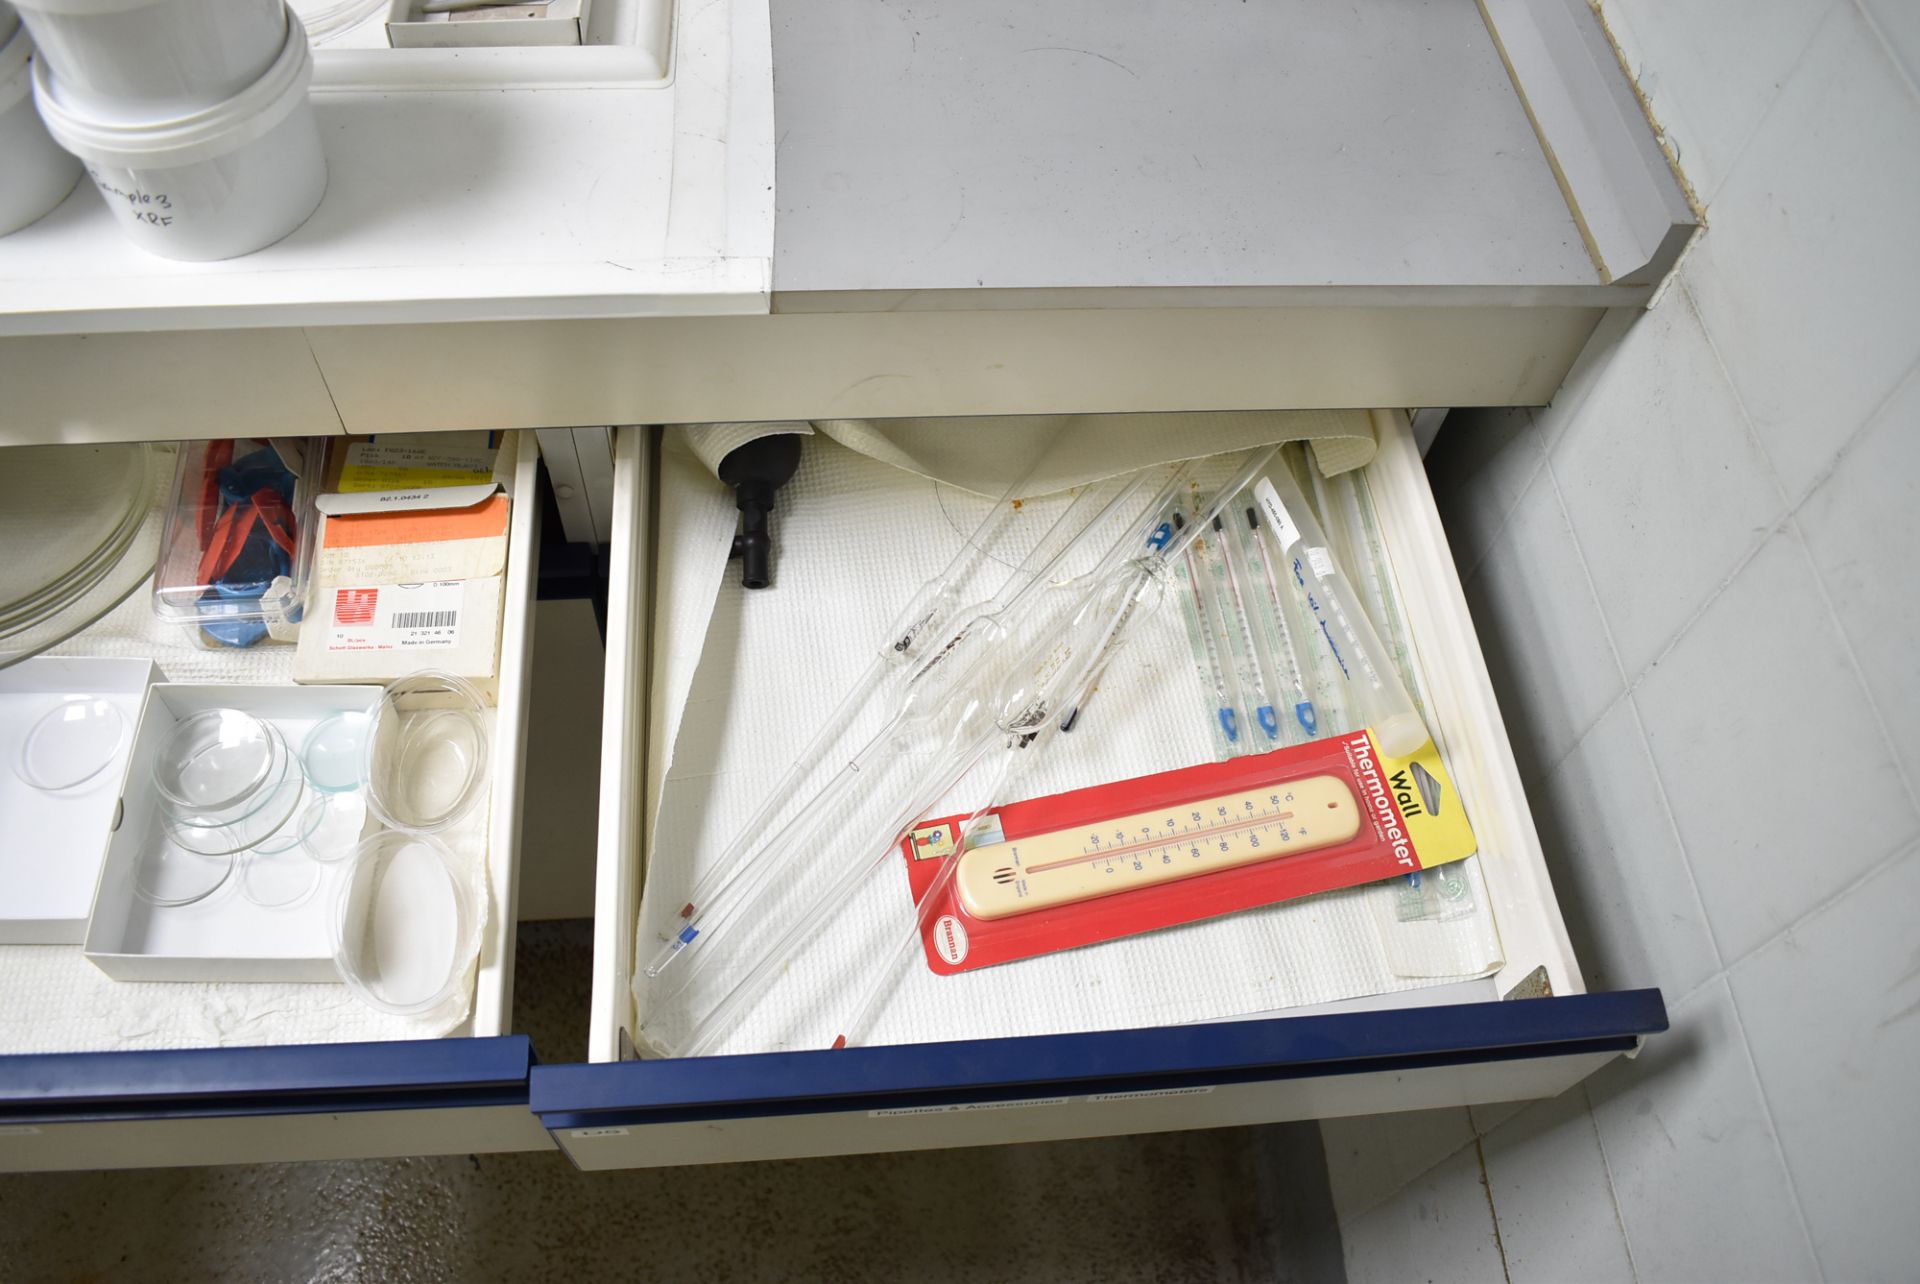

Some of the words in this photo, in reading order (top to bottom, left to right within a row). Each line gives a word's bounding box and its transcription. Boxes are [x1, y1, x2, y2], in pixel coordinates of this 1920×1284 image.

[155, 194, 172, 209] 3
[1166, 818, 1175, 827] 10
[1192, 811, 1201, 821] 20
[1217, 806, 1227, 816] 30
[1244, 800, 1254, 810] 40
[1269, 795, 1280, 805] 50
[1350, 734, 1414, 867] Thermometer
[1389, 769, 1422, 819] Wall
[1133, 860, 1143, 871] 20
[1162, 855, 1171, 864] 40
[1190, 848, 1200, 858] 60
[1219, 841, 1229, 852] 80
[1249, 834, 1260, 847] 100
[1280, 829, 1290, 841] 120
[943, 919, 958, 960] Brannan
[965, 1099, 1064, 1110] Accessories
[1096, 1088, 1209, 1100] Thermometers
